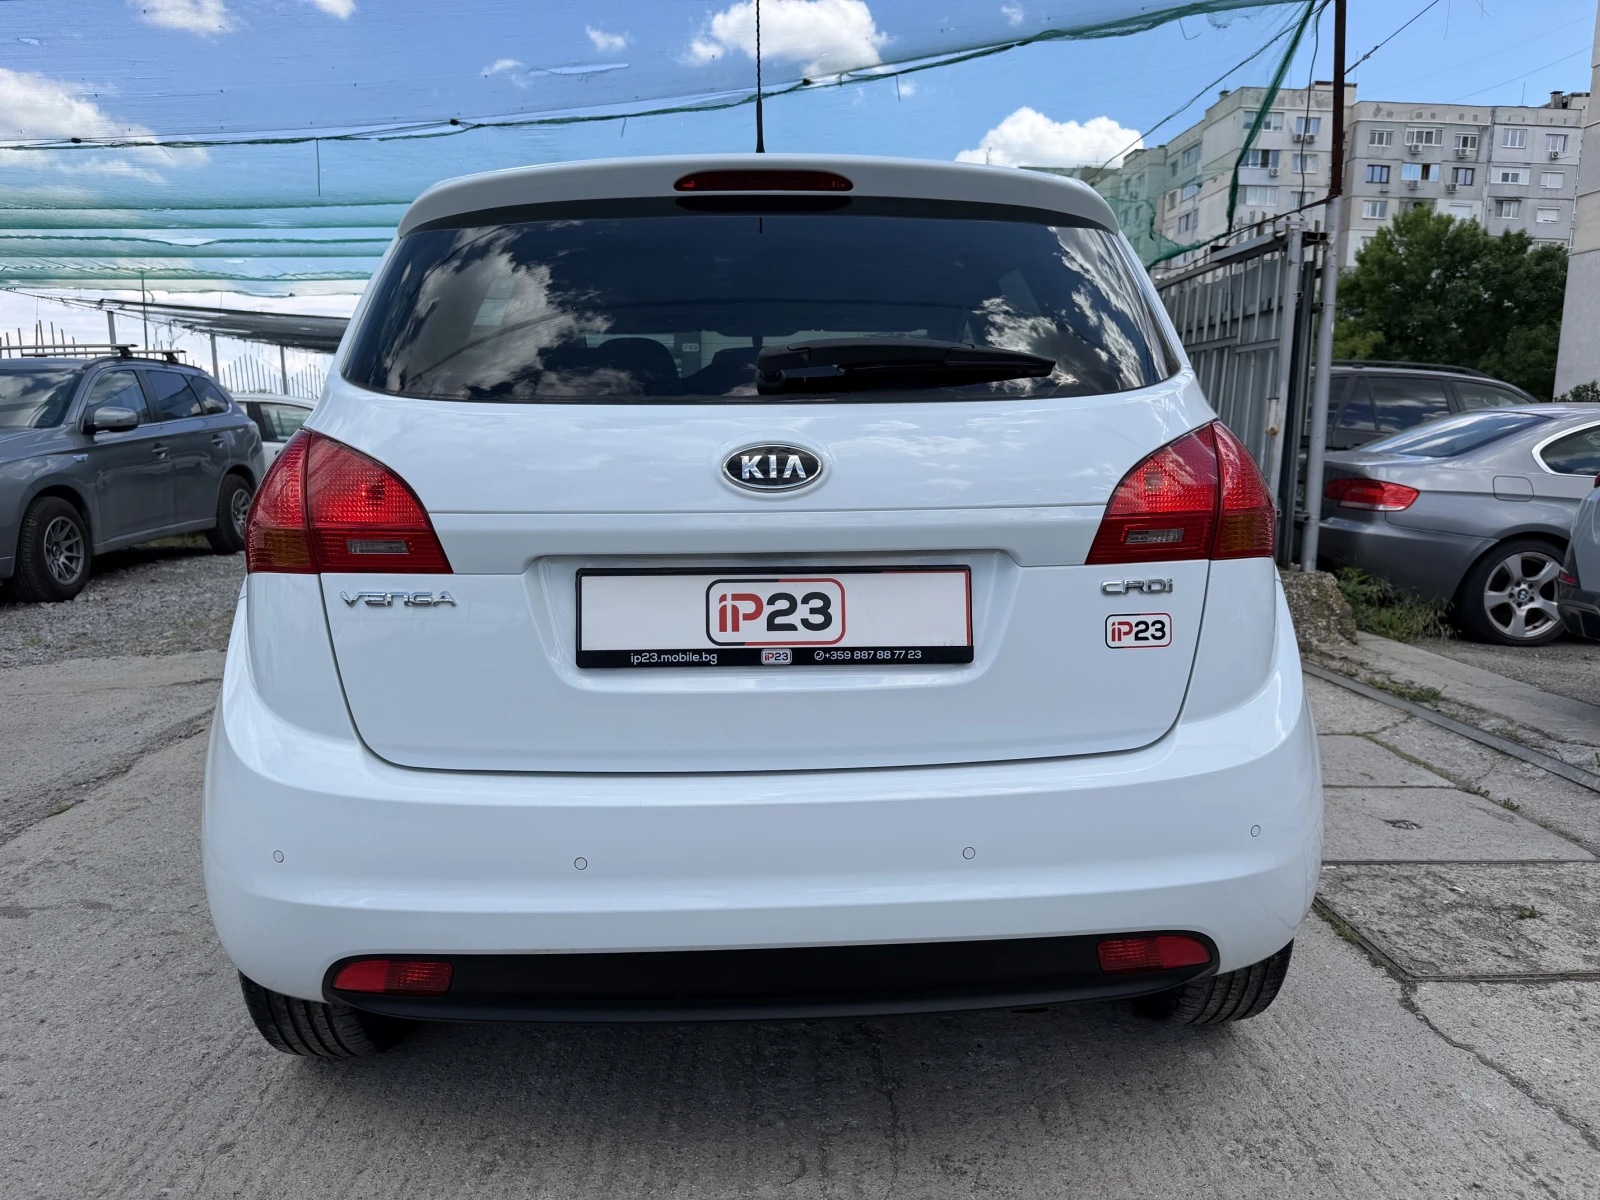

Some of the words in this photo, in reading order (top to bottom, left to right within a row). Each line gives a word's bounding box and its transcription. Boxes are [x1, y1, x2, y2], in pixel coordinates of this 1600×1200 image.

[740, 454, 807, 479] KIA
[630, 652, 718, 665] ip23.mobile.bg
[825, 651, 851, 660] +359
[853, 651, 874, 660] 887
[876, 650, 891, 659] 88
[893, 650, 906, 659] 77
[907, 650, 922, 659] 23
